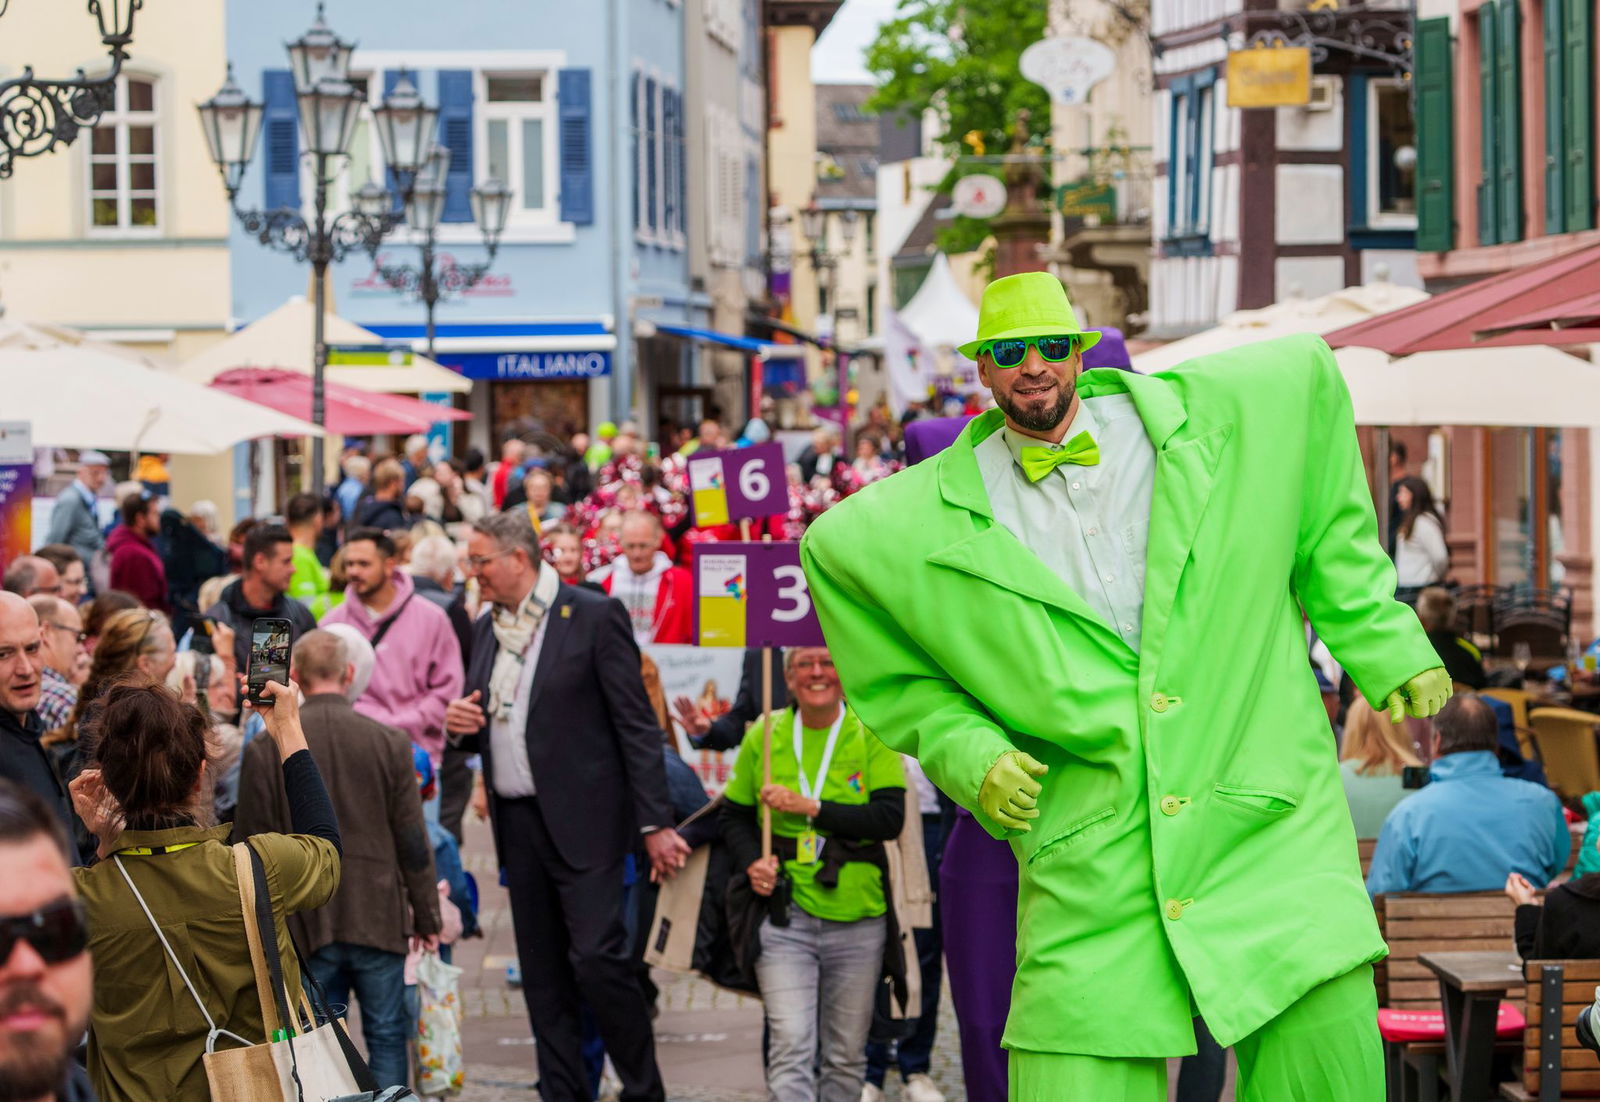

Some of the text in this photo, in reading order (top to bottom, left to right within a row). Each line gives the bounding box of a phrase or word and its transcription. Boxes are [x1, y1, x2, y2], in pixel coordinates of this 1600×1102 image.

[497, 353, 605, 377] ITALIANO
[739, 458, 770, 501] 6
[771, 565, 810, 622] 3
